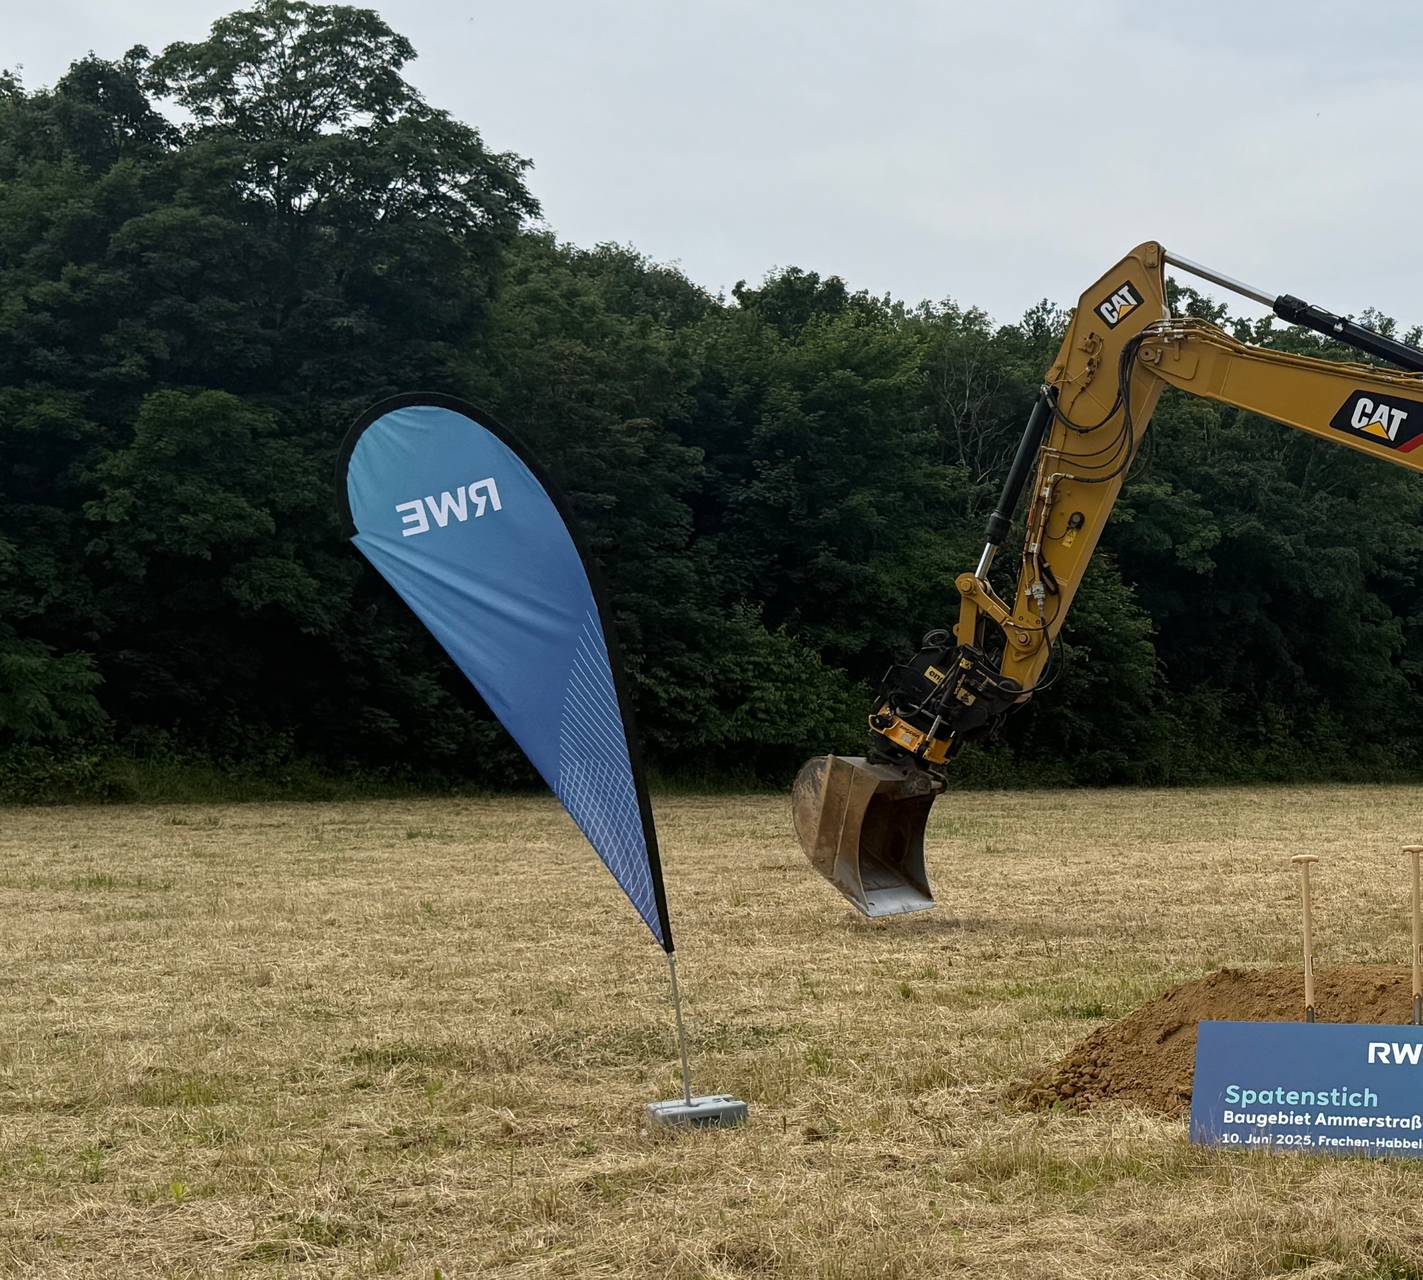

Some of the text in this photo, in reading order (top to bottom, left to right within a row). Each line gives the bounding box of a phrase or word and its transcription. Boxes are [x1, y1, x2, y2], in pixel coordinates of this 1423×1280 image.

[1100, 285, 1138, 324] CAT
[1350, 397, 1408, 441] CAT
[1225, 1084, 1378, 1108] Spatenstich
[1223, 1110, 1312, 1128] Baugebiet
[1222, 1133, 1242, 1144] 10.
[1245, 1133, 1272, 1145] Juni
[1276, 1134, 1315, 1147] 2025,
